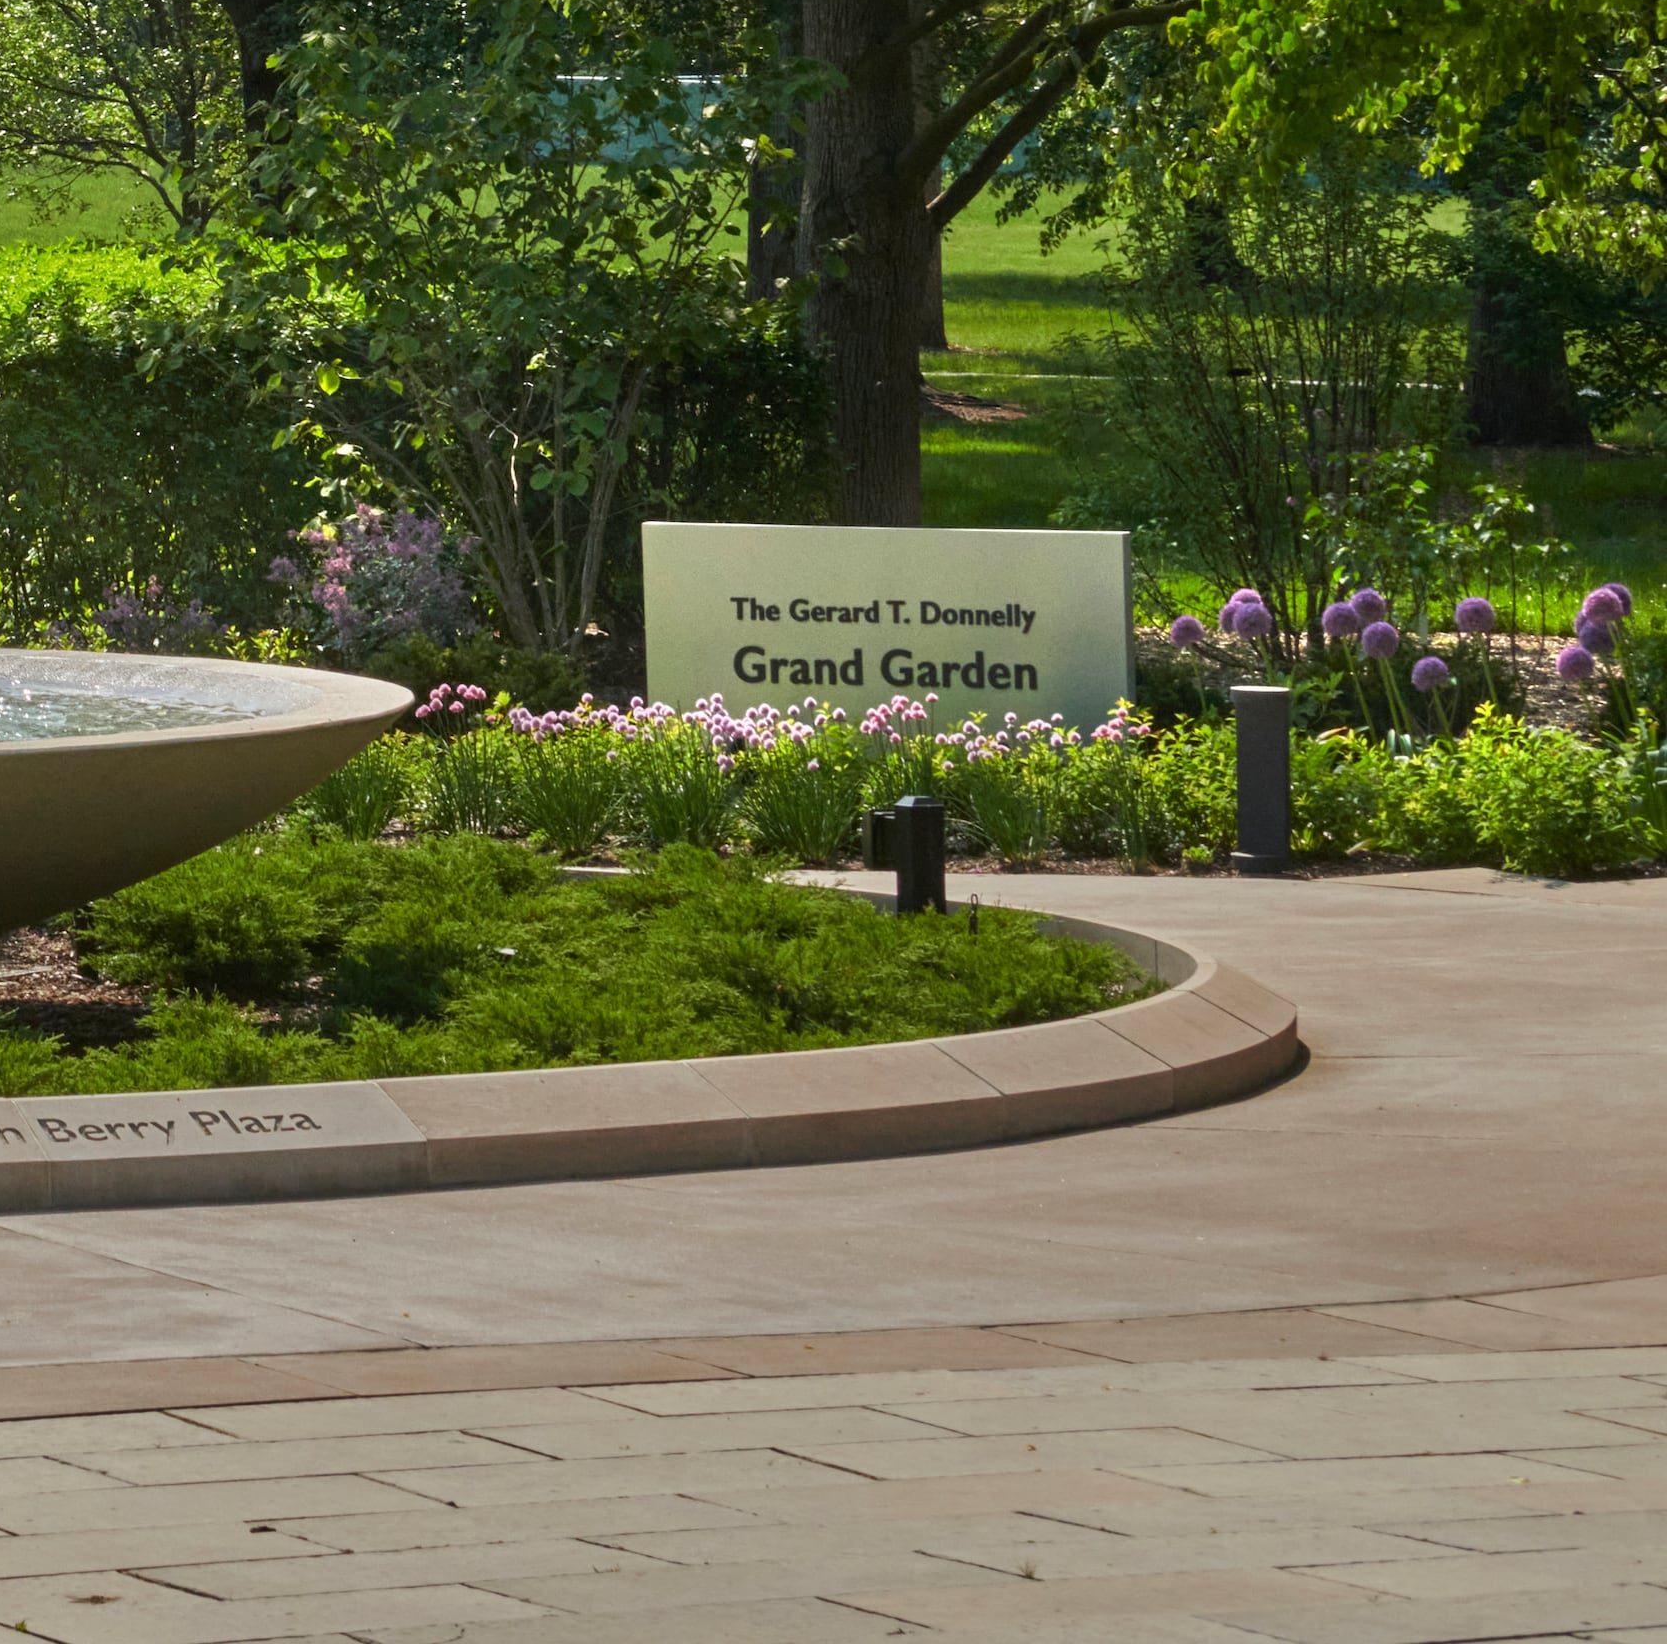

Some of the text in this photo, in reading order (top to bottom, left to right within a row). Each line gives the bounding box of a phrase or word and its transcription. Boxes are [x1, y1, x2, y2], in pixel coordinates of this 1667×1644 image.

[730, 597, 1036, 634] The Gerard T. Donnelly
[733, 645, 1038, 691] Grand Garden
[37, 1118, 175, 1146] Berry
[188, 1109, 322, 1136] Plaza
